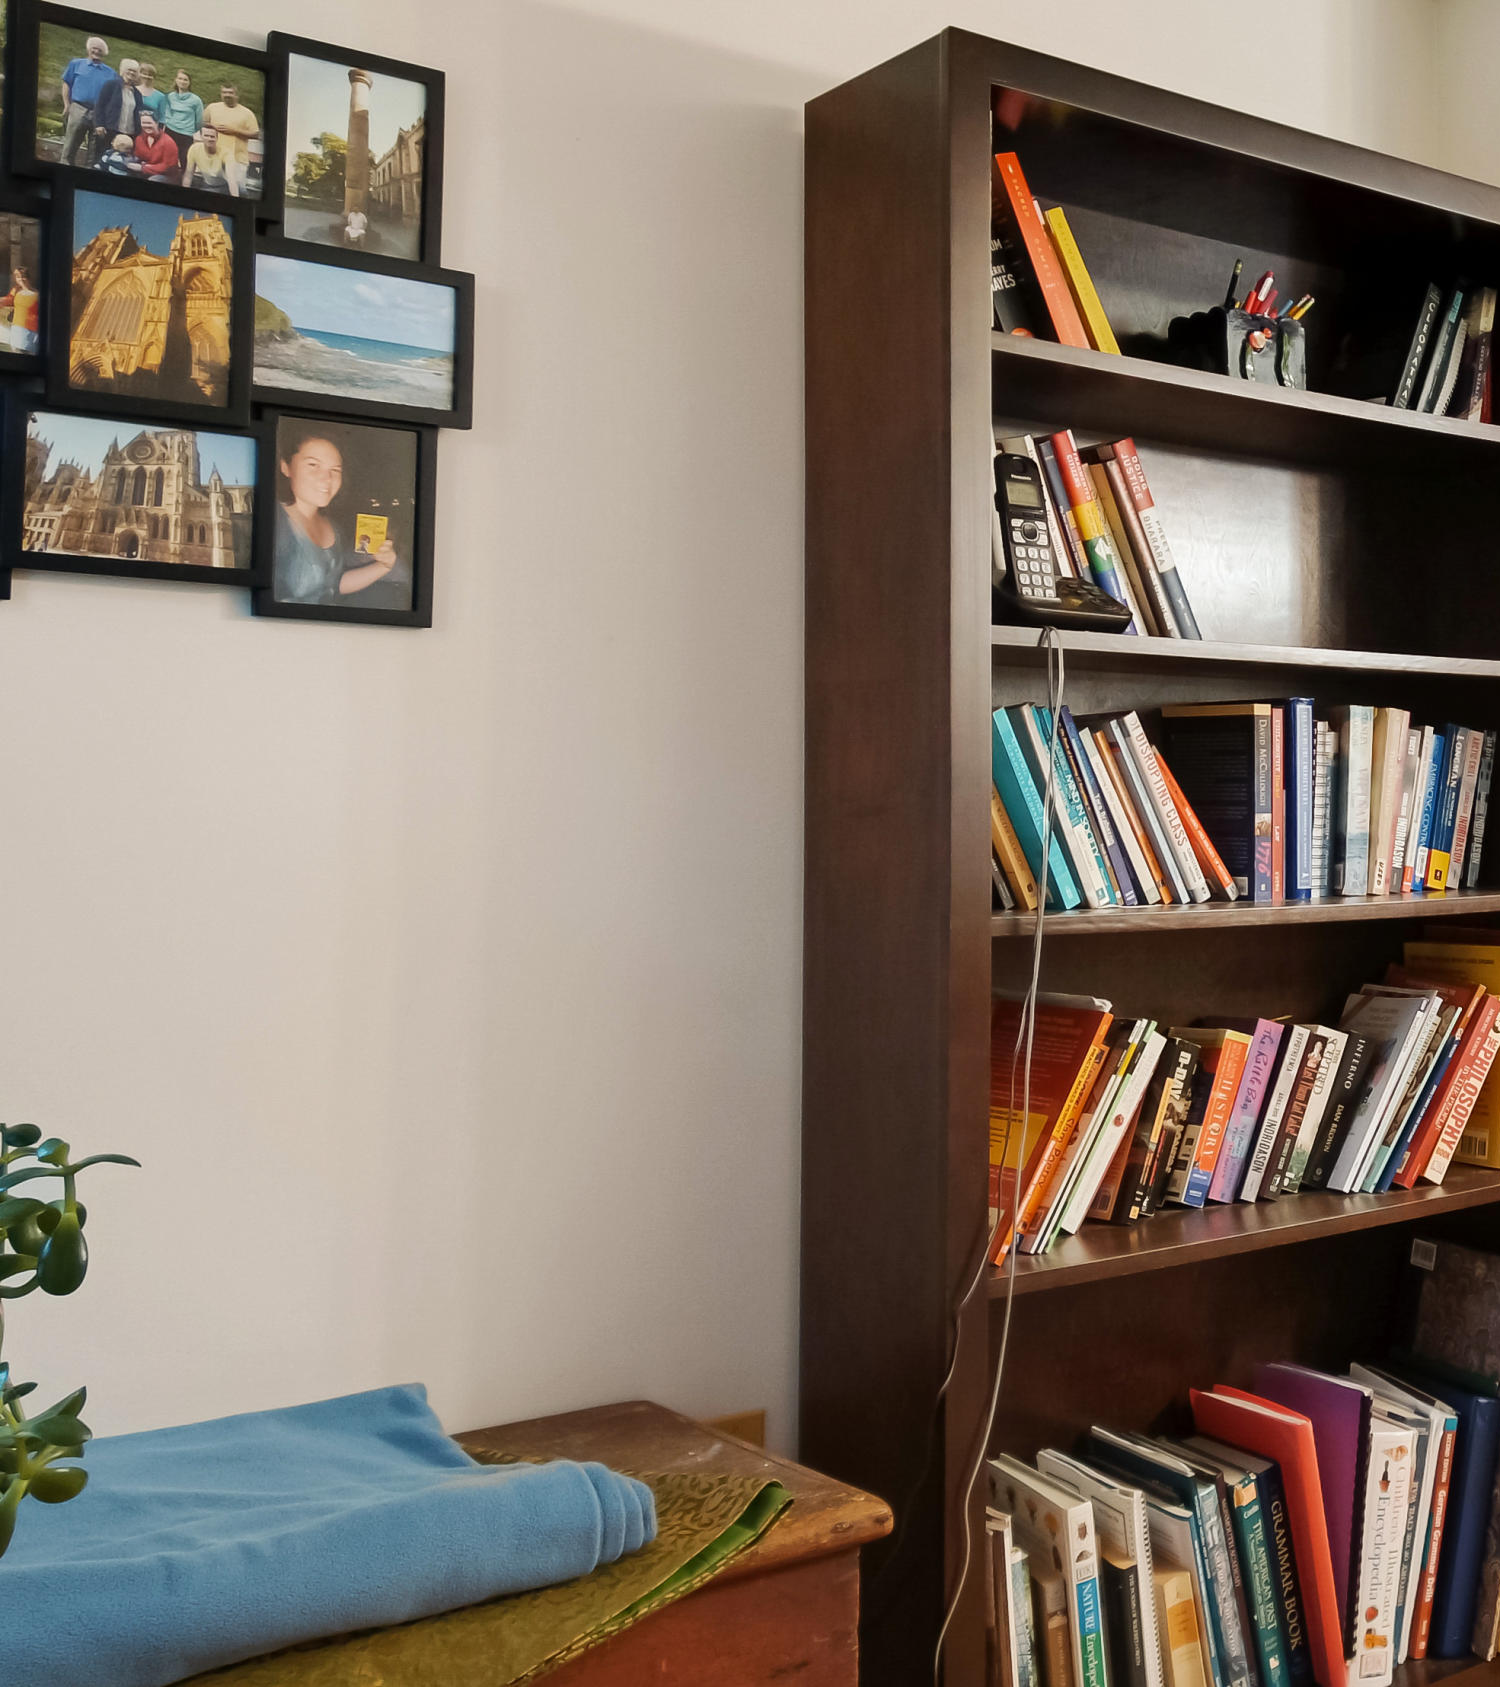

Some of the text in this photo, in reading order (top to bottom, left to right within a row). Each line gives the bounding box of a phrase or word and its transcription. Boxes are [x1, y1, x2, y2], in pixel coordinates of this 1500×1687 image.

[1402, 302, 1436, 399] CLEOPATRA
[1067, 454, 1080, 488] CITIZENS
[1072, 452, 1090, 500] FRAGMENTED
[1120, 452, 1142, 500] JUSTICE
[1131, 455, 1147, 490] DOING
[1143, 515, 1165, 565] BHARARA
[1451, 735, 1463, 787] LONGMAN
[1467, 736, 1480, 777] ARCTIC CHILL
[1135, 732, 1186, 846] DISRUPTING CLASS
[1420, 762, 1436, 846] EMBRACING CONTRA
[1066, 774, 1099, 857] MIND IN SOCIETY
[1454, 815, 1466, 864] INDRIDASON
[1471, 815, 1483, 864] INDRIDASON
[1258, 841, 1270, 878] 1776
[1392, 817, 1406, 868] INDRIDASON
[1376, 860, 1385, 887] USED
[1260, 1029, 1274, 1046] The
[1286, 1032, 1304, 1072] HYPOTHERMIA
[1170, 1050, 1192, 1100] D-DAY
[1314, 1036, 1338, 1095] SCEPTRED
[1343, 1039, 1365, 1089] INFERNO
[1453, 1078, 1463, 1095] THE
[1462, 1065, 1470, 1075] BY
[1202, 1078, 1233, 1160] HISTORY
[1240, 1088, 1256, 1112] Bag
[1435, 1096, 1454, 1131] PEOPLE
[1446, 1046, 1495, 1151] PHILOSOPHY
[1057, 1117, 1074, 1144] Slam
[1252, 1118, 1278, 1174] INDRIDASON
[1324, 1104, 1343, 1152] DAN BROWN
[1410, 1481, 1418, 1502] WAR
[1252, 1520, 1263, 1541] THE
[1406, 1505, 1414, 1530] CIVIL
[1366, 1495, 1388, 1601] Encyclopedia
[1381, 1466, 1406, 1628] Children's Illustrated
[1402, 1551, 1409, 1561] OF
[1425, 1490, 1445, 1602] German Grammar Drills
[1257, 1547, 1271, 1601] AMERICAN
[1272, 1500, 1301, 1650] GRAMMAR BOOK
[1398, 1564, 1407, 1606] HISTORY
[1081, 1583, 1100, 1687] NATURE Encyclope
[1223, 1602, 1237, 1657] EDUCATION
[1264, 1602, 1276, 1630] PAST
